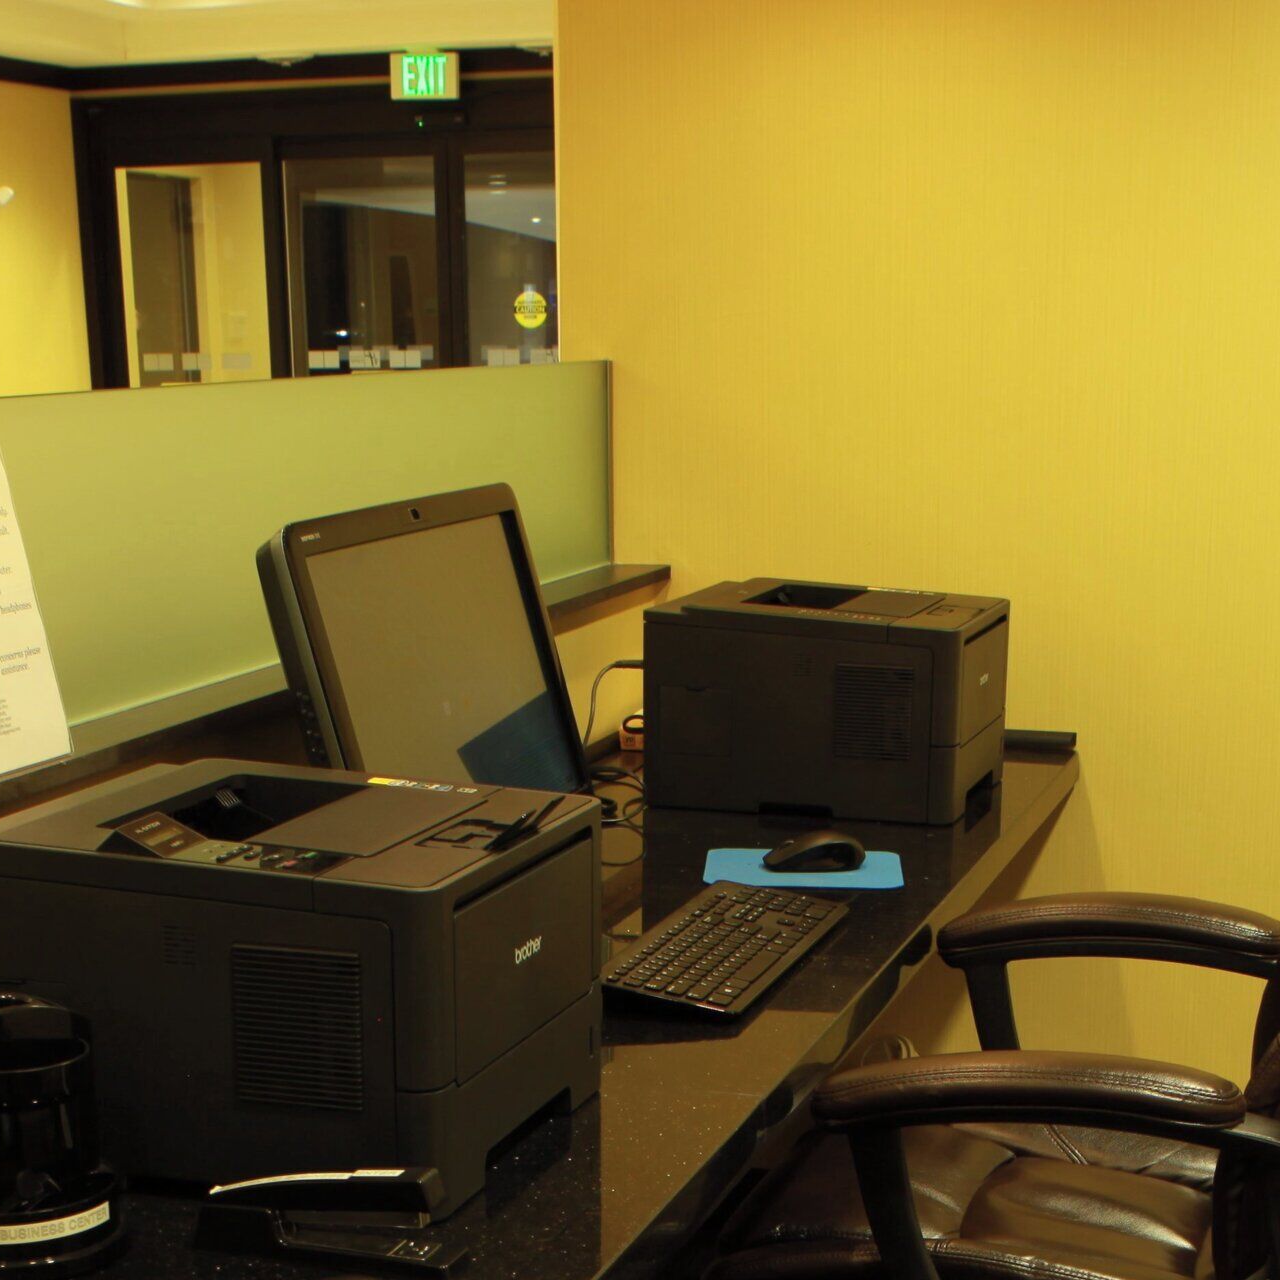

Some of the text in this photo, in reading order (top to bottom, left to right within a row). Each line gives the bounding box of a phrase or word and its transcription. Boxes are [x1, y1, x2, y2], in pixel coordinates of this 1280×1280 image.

[402, 55, 446, 96] EXIT
[0, 602, 31, 615] headphones
[0, 651, 24, 662] concerns
[24, 646, 41, 659] please
[515, 936, 542, 964] brother
[0, 1207, 108, 1241] BUSINESS CENTER
